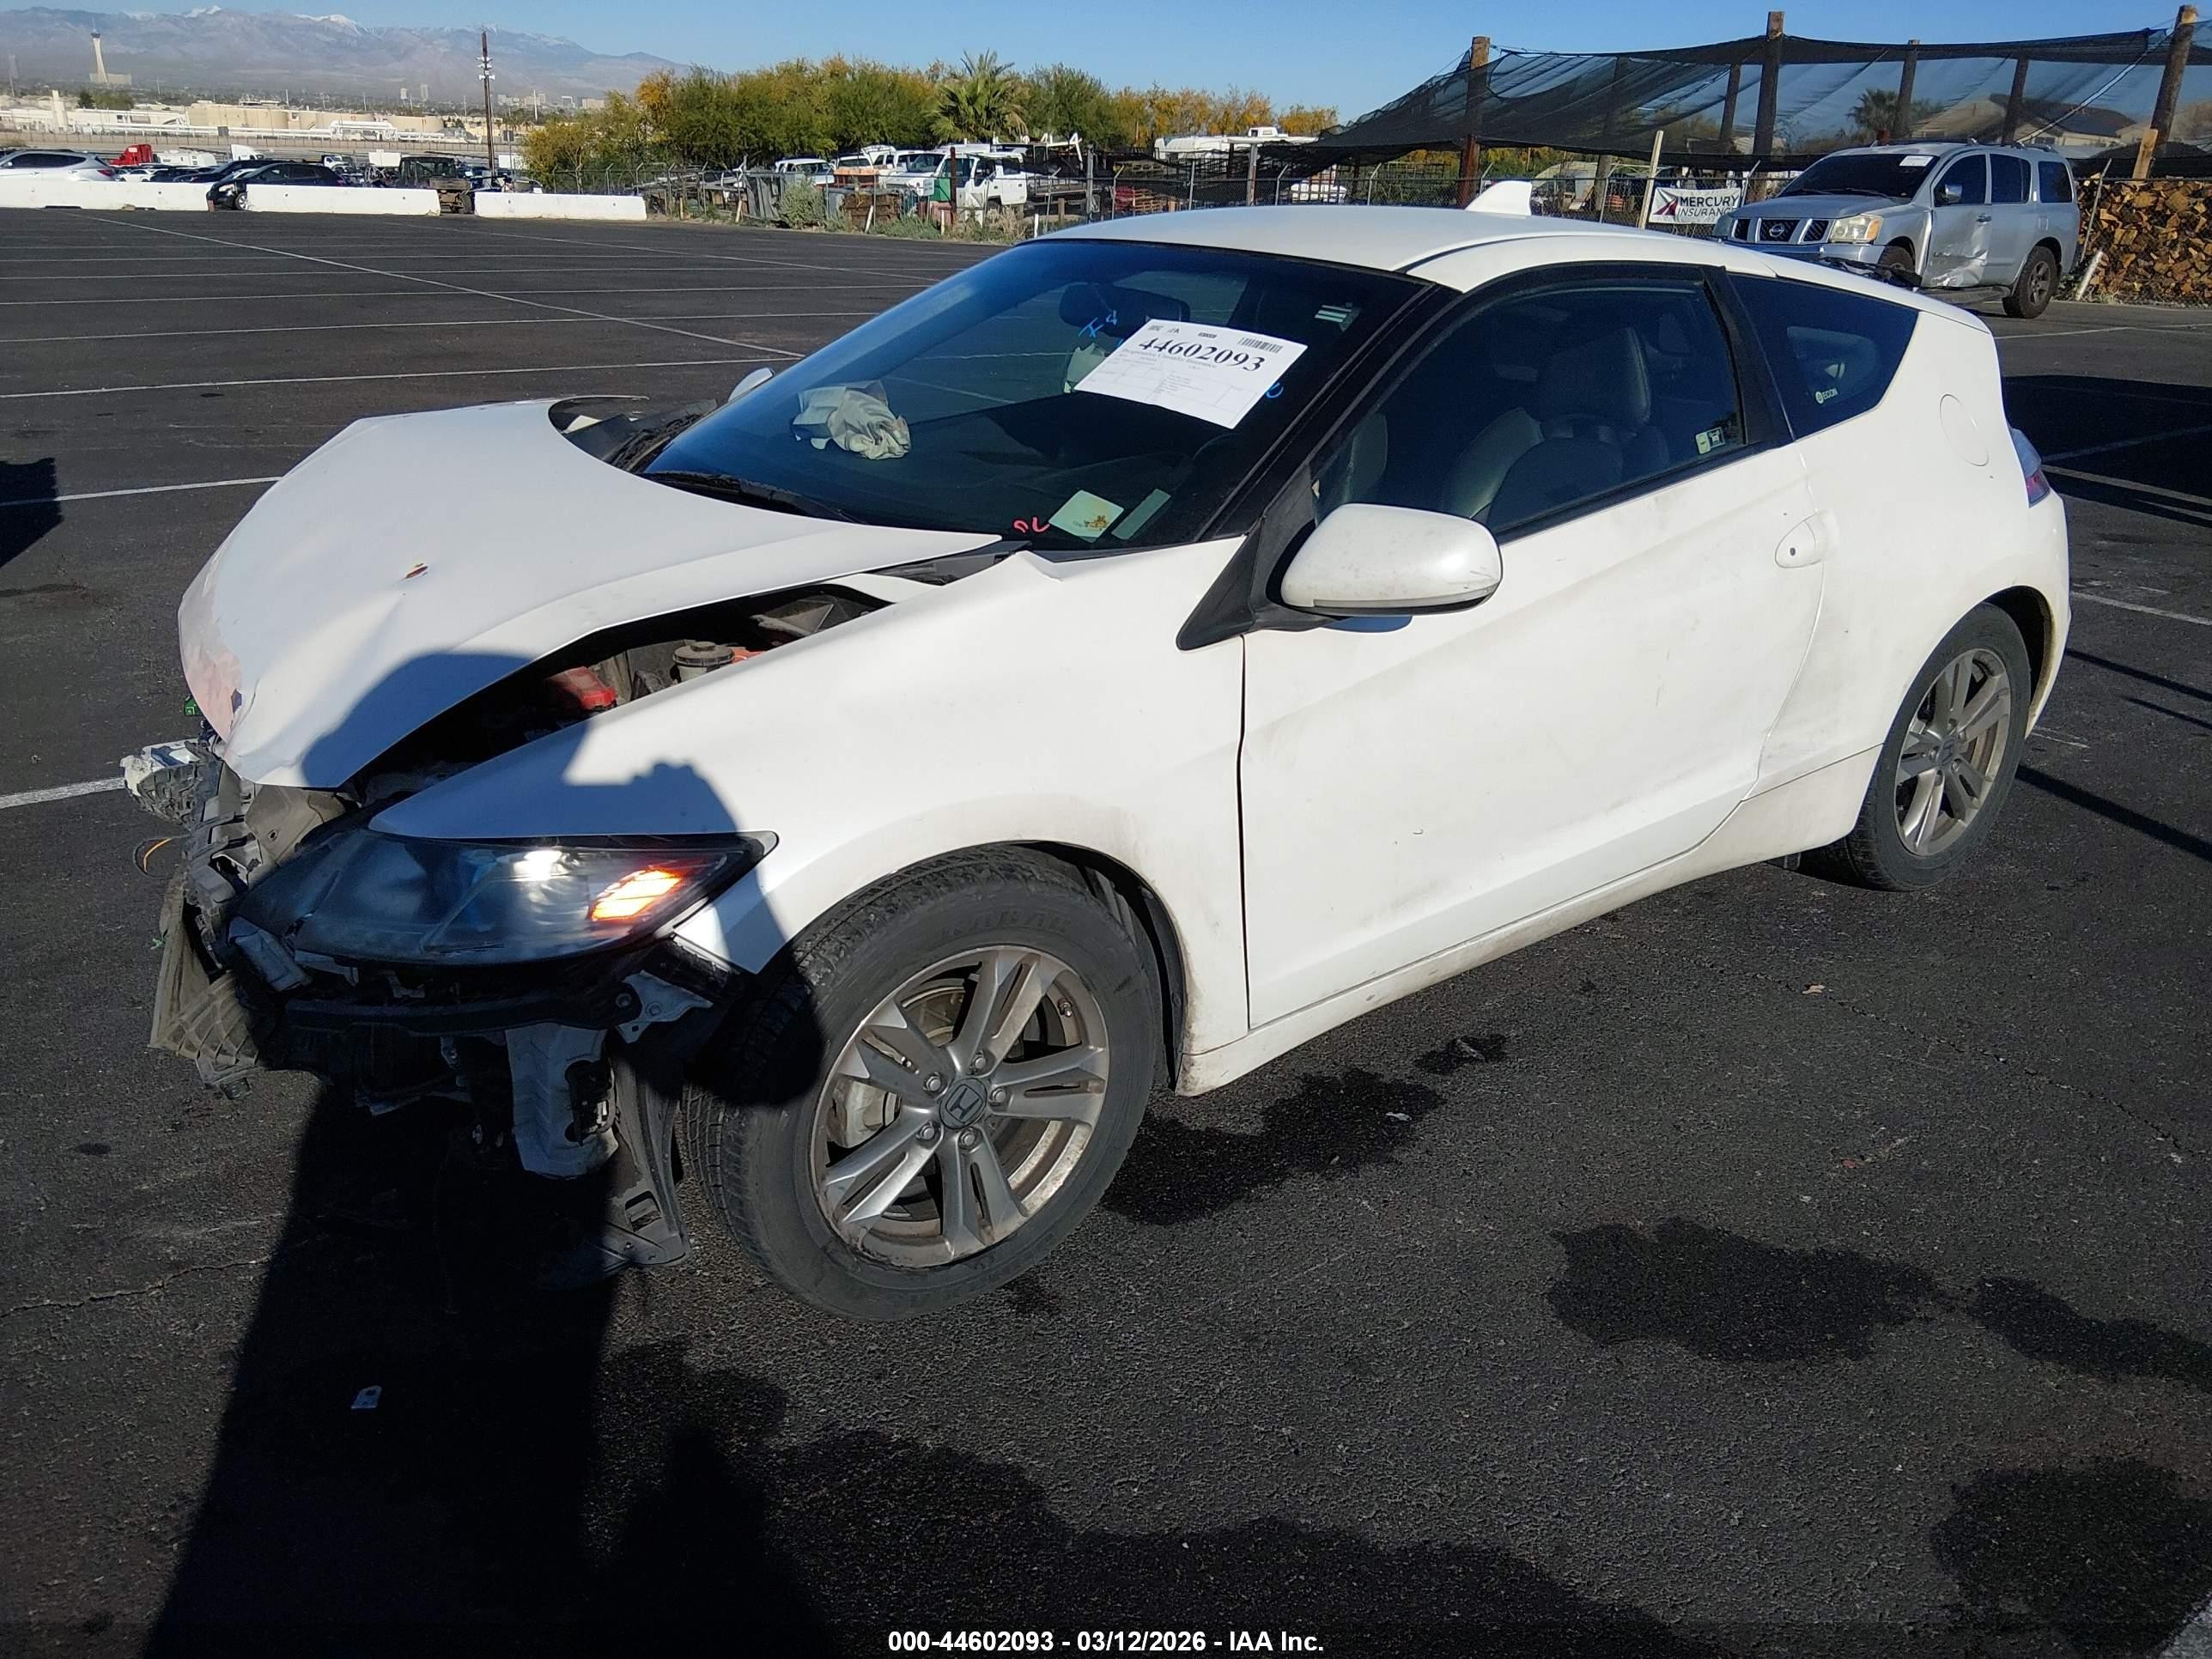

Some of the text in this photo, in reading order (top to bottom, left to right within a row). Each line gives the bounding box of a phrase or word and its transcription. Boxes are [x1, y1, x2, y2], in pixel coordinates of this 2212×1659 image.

[1680, 195, 1737, 207] MERCURY
[1677, 206, 1737, 217] INSURANC
[1139, 337, 1266, 372] 44602093
